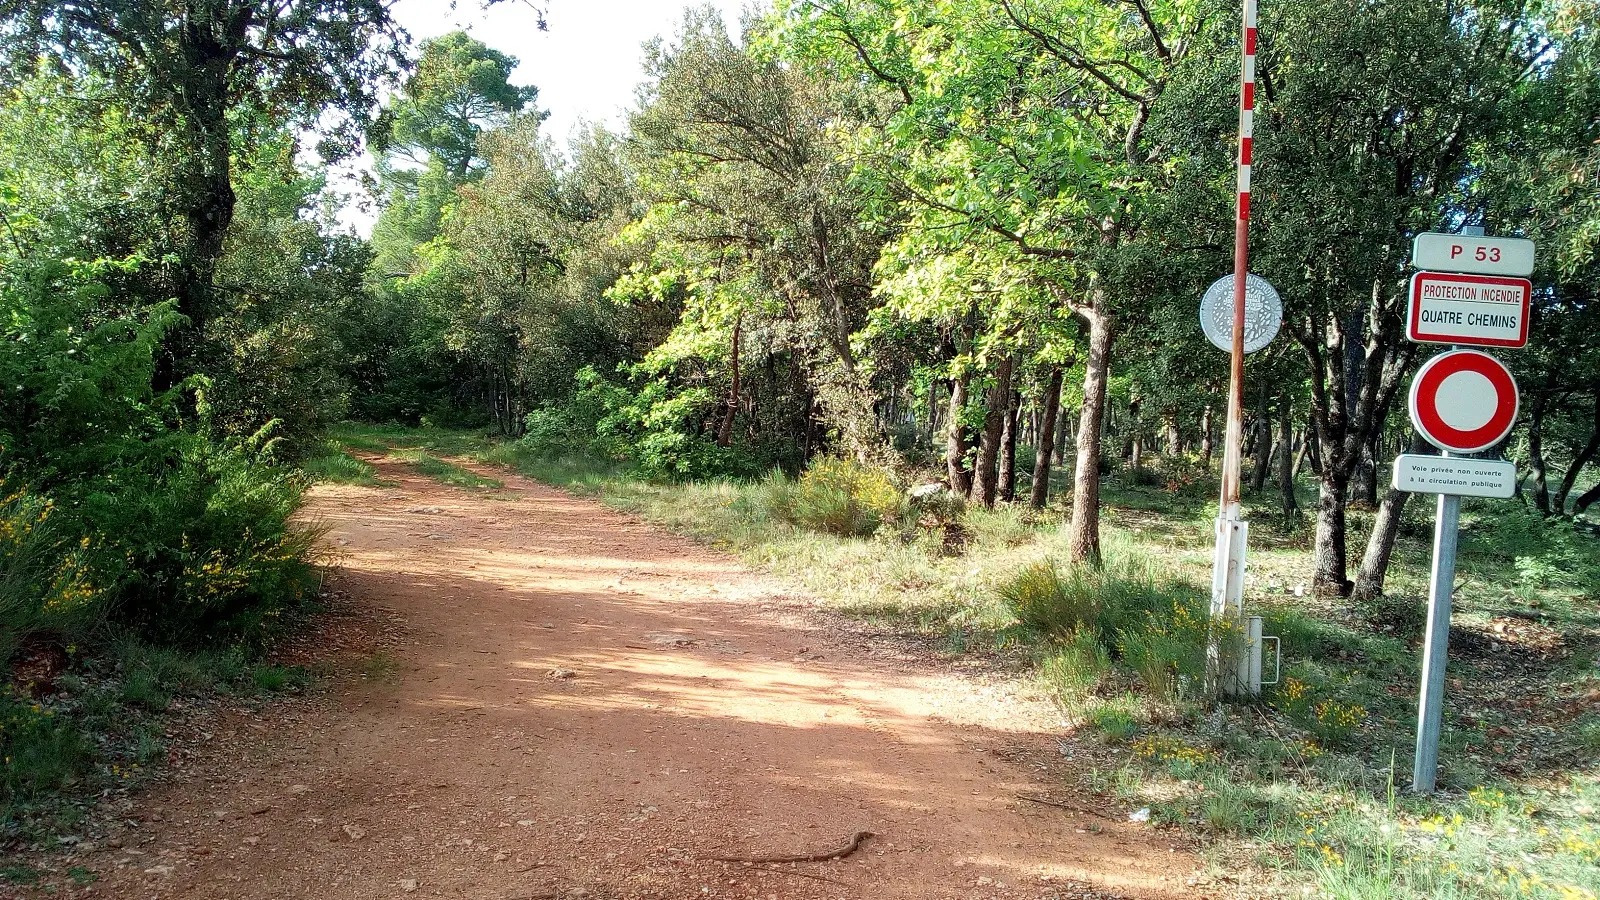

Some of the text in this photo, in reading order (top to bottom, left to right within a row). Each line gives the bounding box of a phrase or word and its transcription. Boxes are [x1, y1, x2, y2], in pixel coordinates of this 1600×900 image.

[1450, 245, 1501, 262] P 53
[1424, 284, 1521, 303] PROTECTION INCENDIE
[1421, 309, 1516, 329] QUATRE CHEMINS
[1431, 466, 1454, 474] privée
[1474, 469, 1502, 477] ouverte
[1428, 477, 1468, 486] circulation
[1471, 480, 1503, 489] publique
